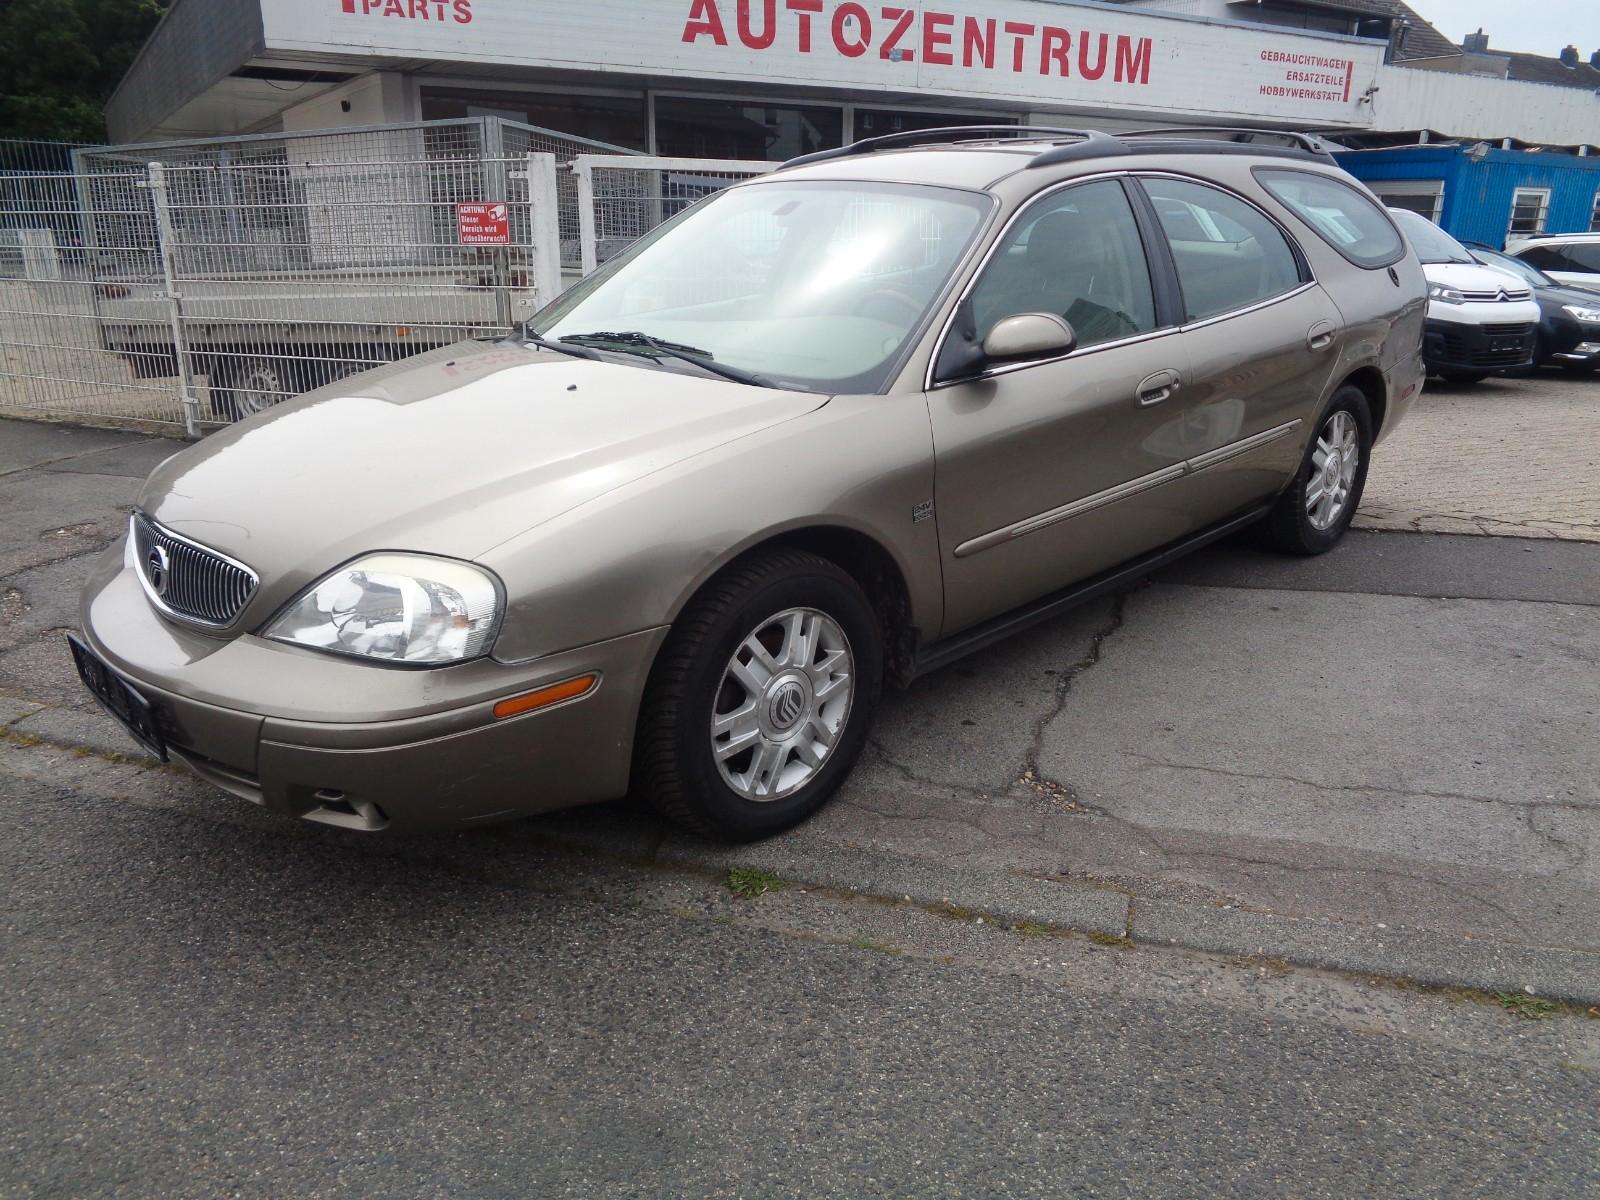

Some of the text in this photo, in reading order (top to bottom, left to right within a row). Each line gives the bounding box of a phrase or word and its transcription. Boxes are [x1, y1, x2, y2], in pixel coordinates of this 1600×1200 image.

[362, 0, 472, 24] PARTS
[682, 0, 1152, 84] AUTOZENTRUM
[1260, 50, 1346, 70] GEBRAUCHTWAGEN
[1286, 71, 1344, 86] ERSATZTEILE
[1259, 85, 1342, 102] HOBBYWERKSTATT
